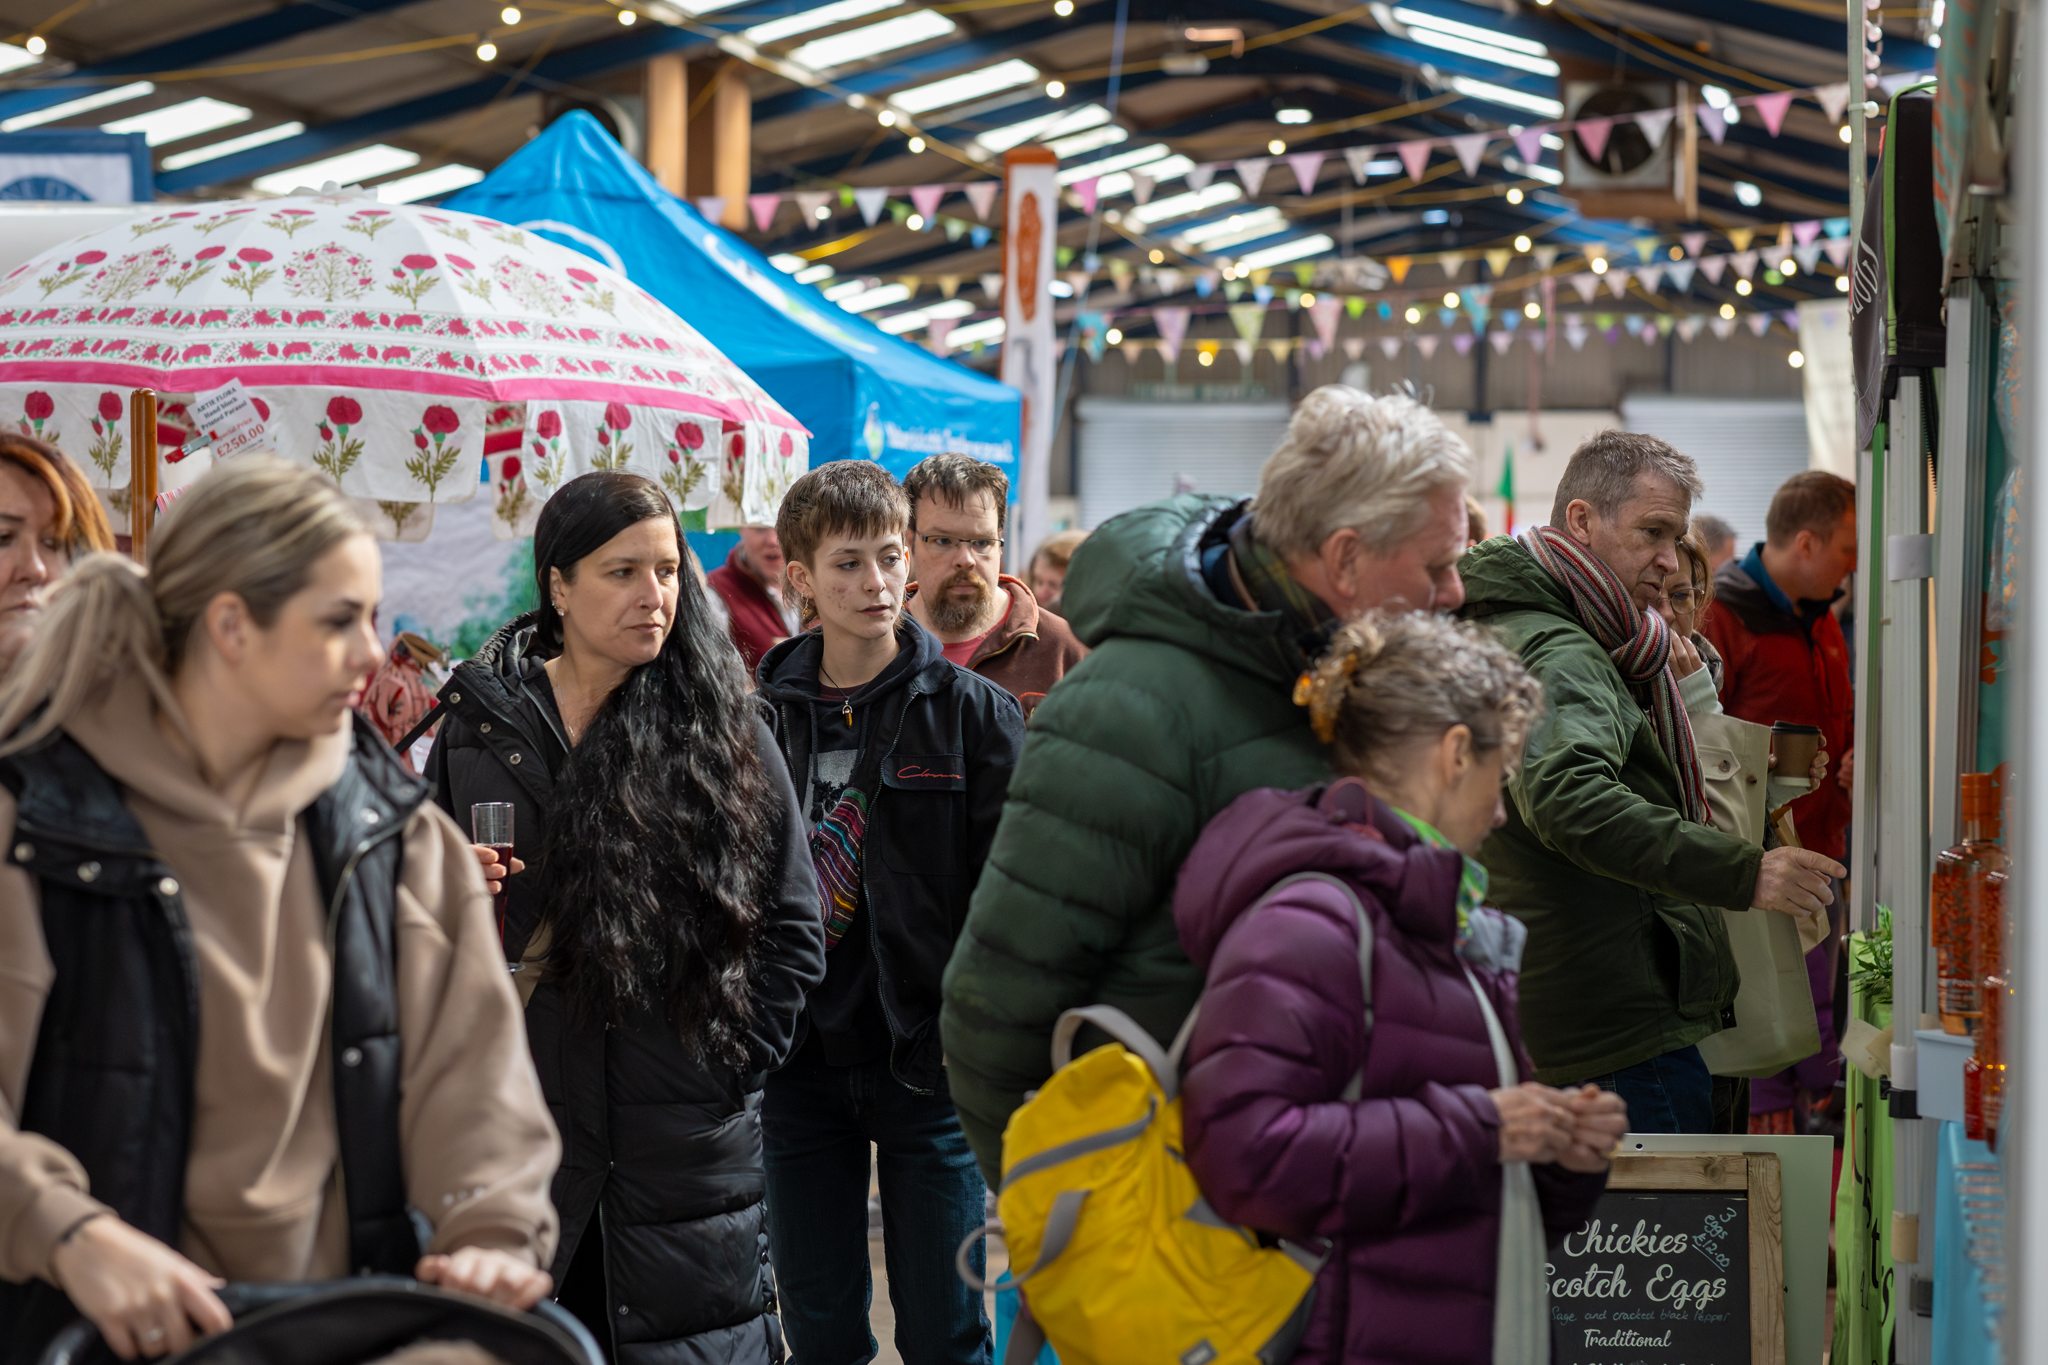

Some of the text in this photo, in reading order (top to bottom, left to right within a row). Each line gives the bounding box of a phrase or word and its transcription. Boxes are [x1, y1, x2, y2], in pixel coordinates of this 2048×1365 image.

[216, 387, 237, 402] FLORA
[201, 400, 247, 430] Printed Parasol
[204, 396, 238, 419] Hand block
[216, 423, 265, 458] £250.00
[1704, 1214, 1728, 1239] eggs
[1719, 1206, 1737, 1223] 3
[1563, 1219, 1688, 1257] Chickies
[1691, 1232, 1731, 1268] £12.00
[1645, 1264, 1727, 1310] Eggs
[1551, 1305, 1578, 1326] Sage
[1584, 1310, 1607, 1320] and
[1612, 1308, 1656, 1321] cracked
[1660, 1308, 1689, 1321] black
[1584, 1328, 1672, 1348] Traditional
